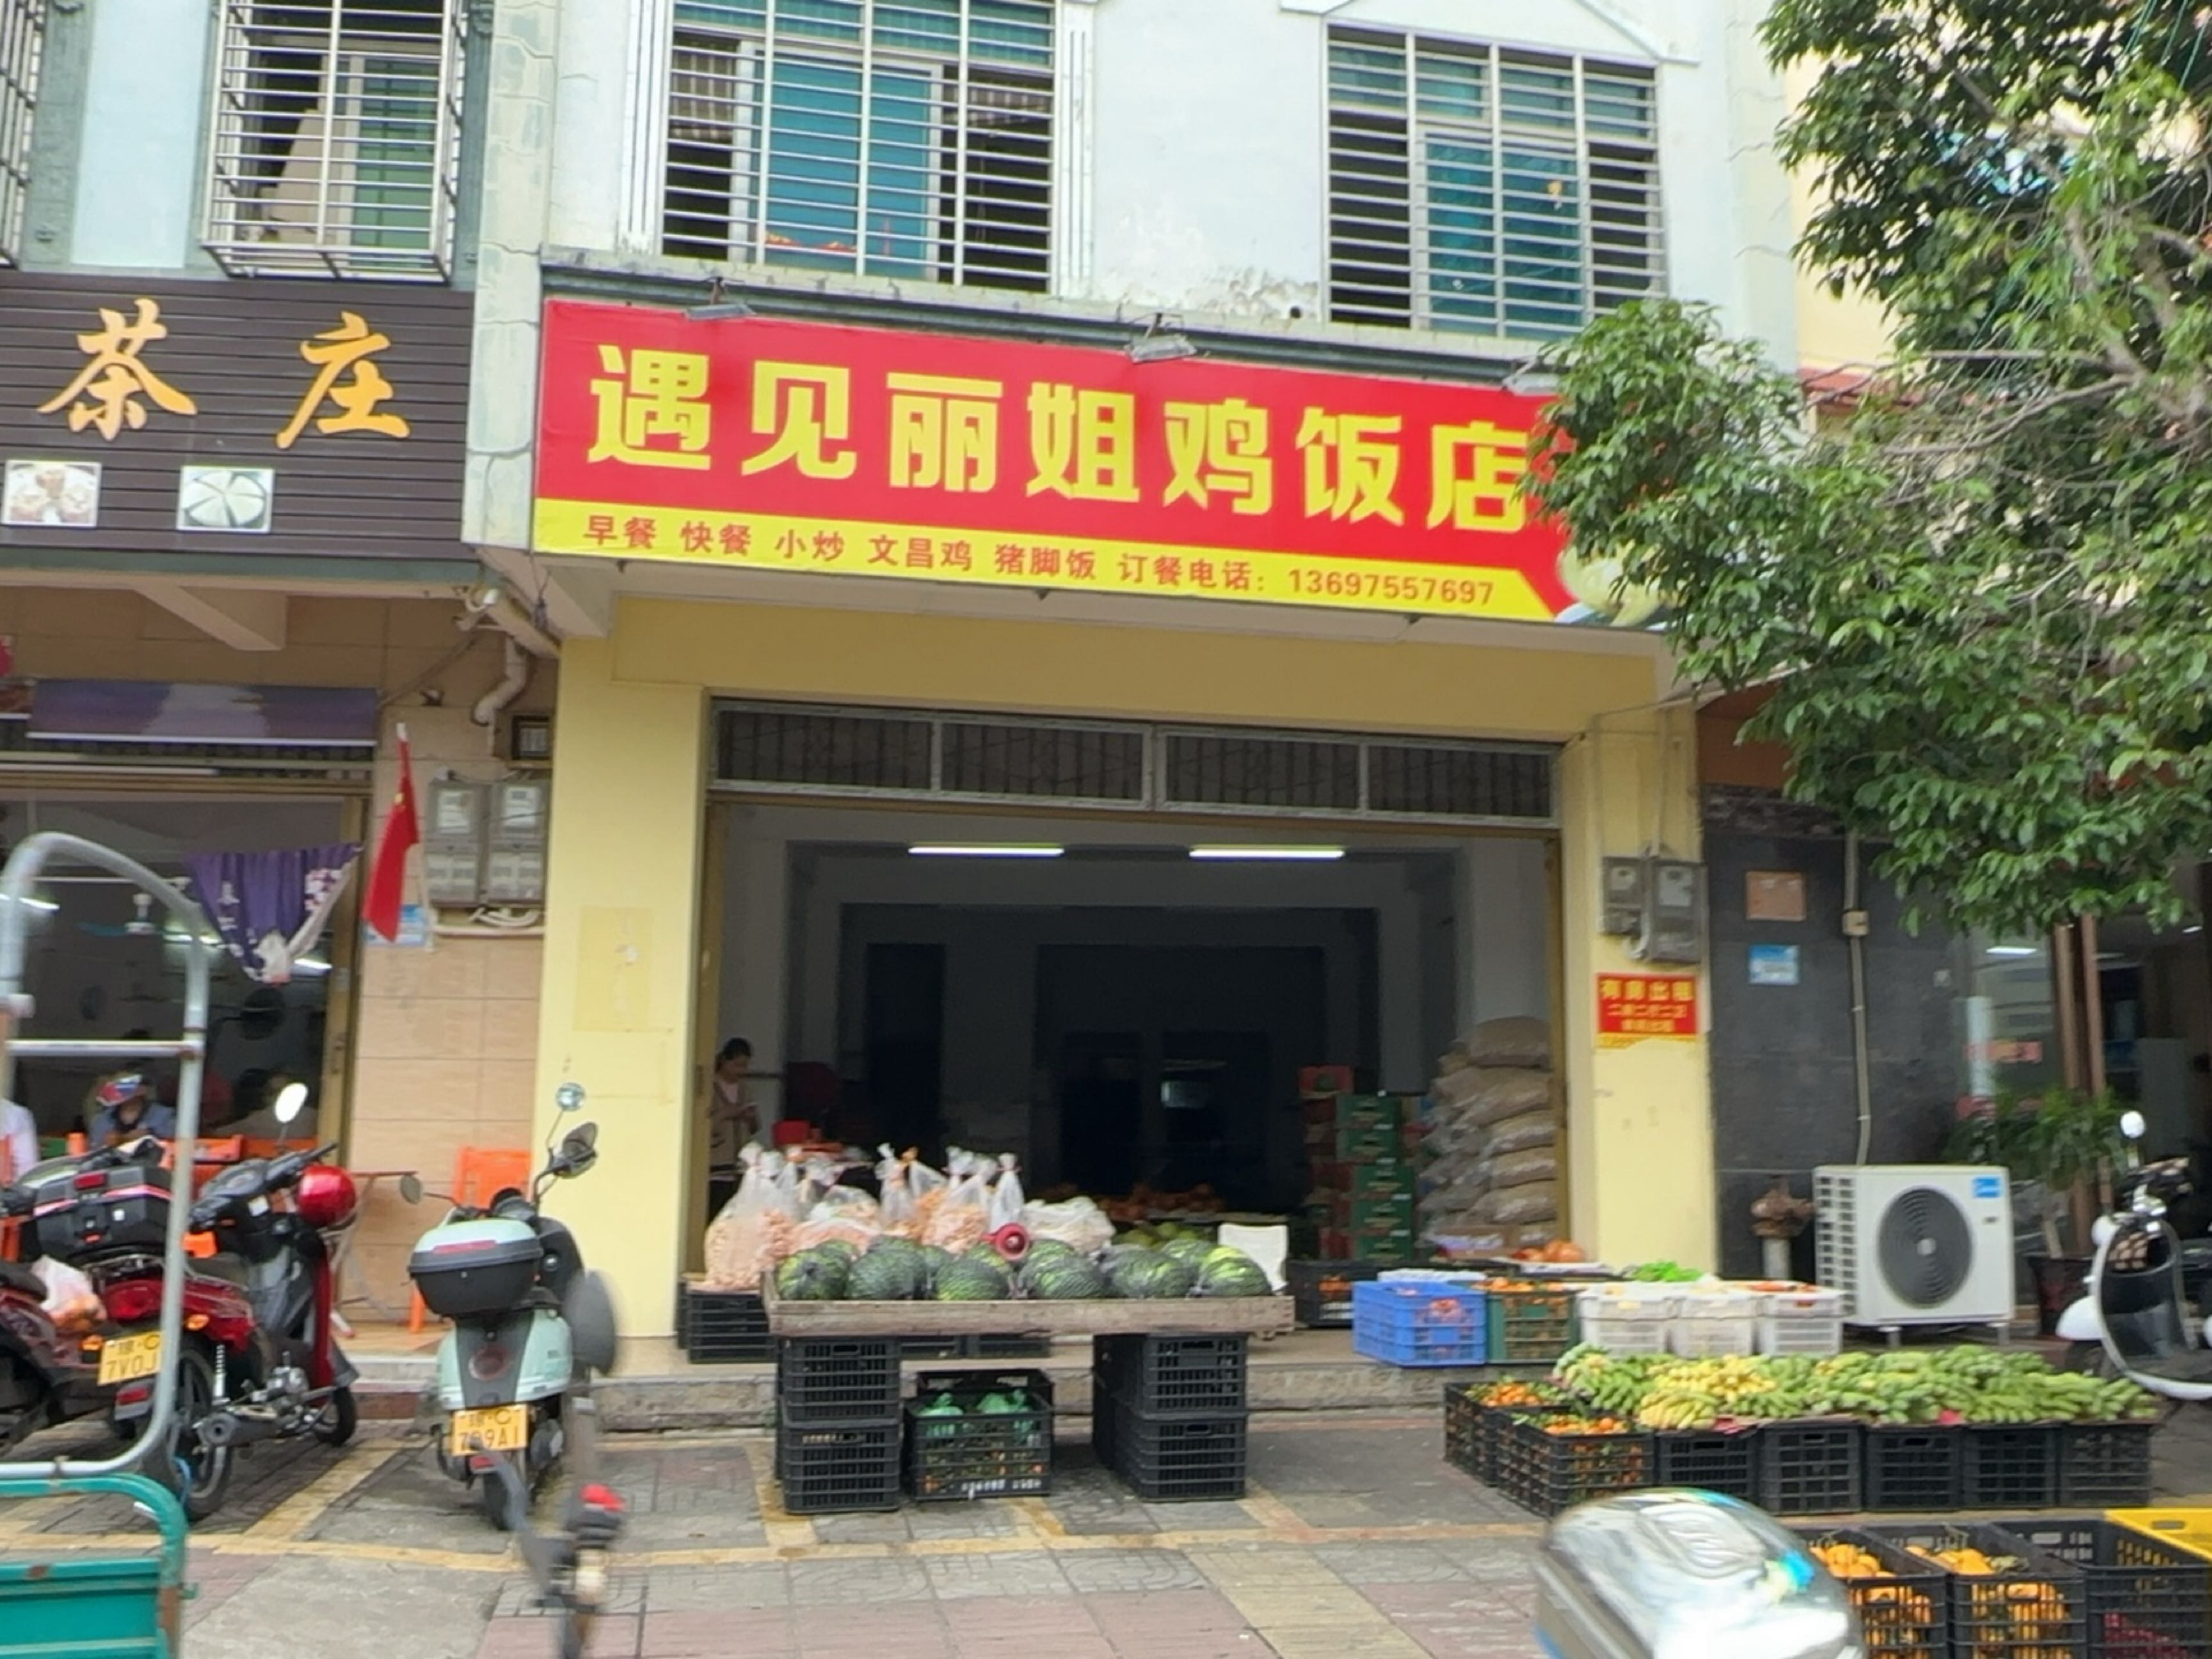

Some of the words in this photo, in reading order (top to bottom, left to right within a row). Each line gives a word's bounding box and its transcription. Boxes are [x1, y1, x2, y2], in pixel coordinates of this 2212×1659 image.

[36, 298, 411, 450] 茶庄
[587, 344, 1528, 534] 遇见丽姐鸡饭店
[583, 515, 657, 549] 早餐
[680, 520, 753, 556] 快餐
[774, 529, 846, 562] 小炒
[867, 534, 973, 572] 文昌鸡
[994, 542, 1097, 581] 猪脚饭
[1287, 567, 1495, 606] 13697557697
